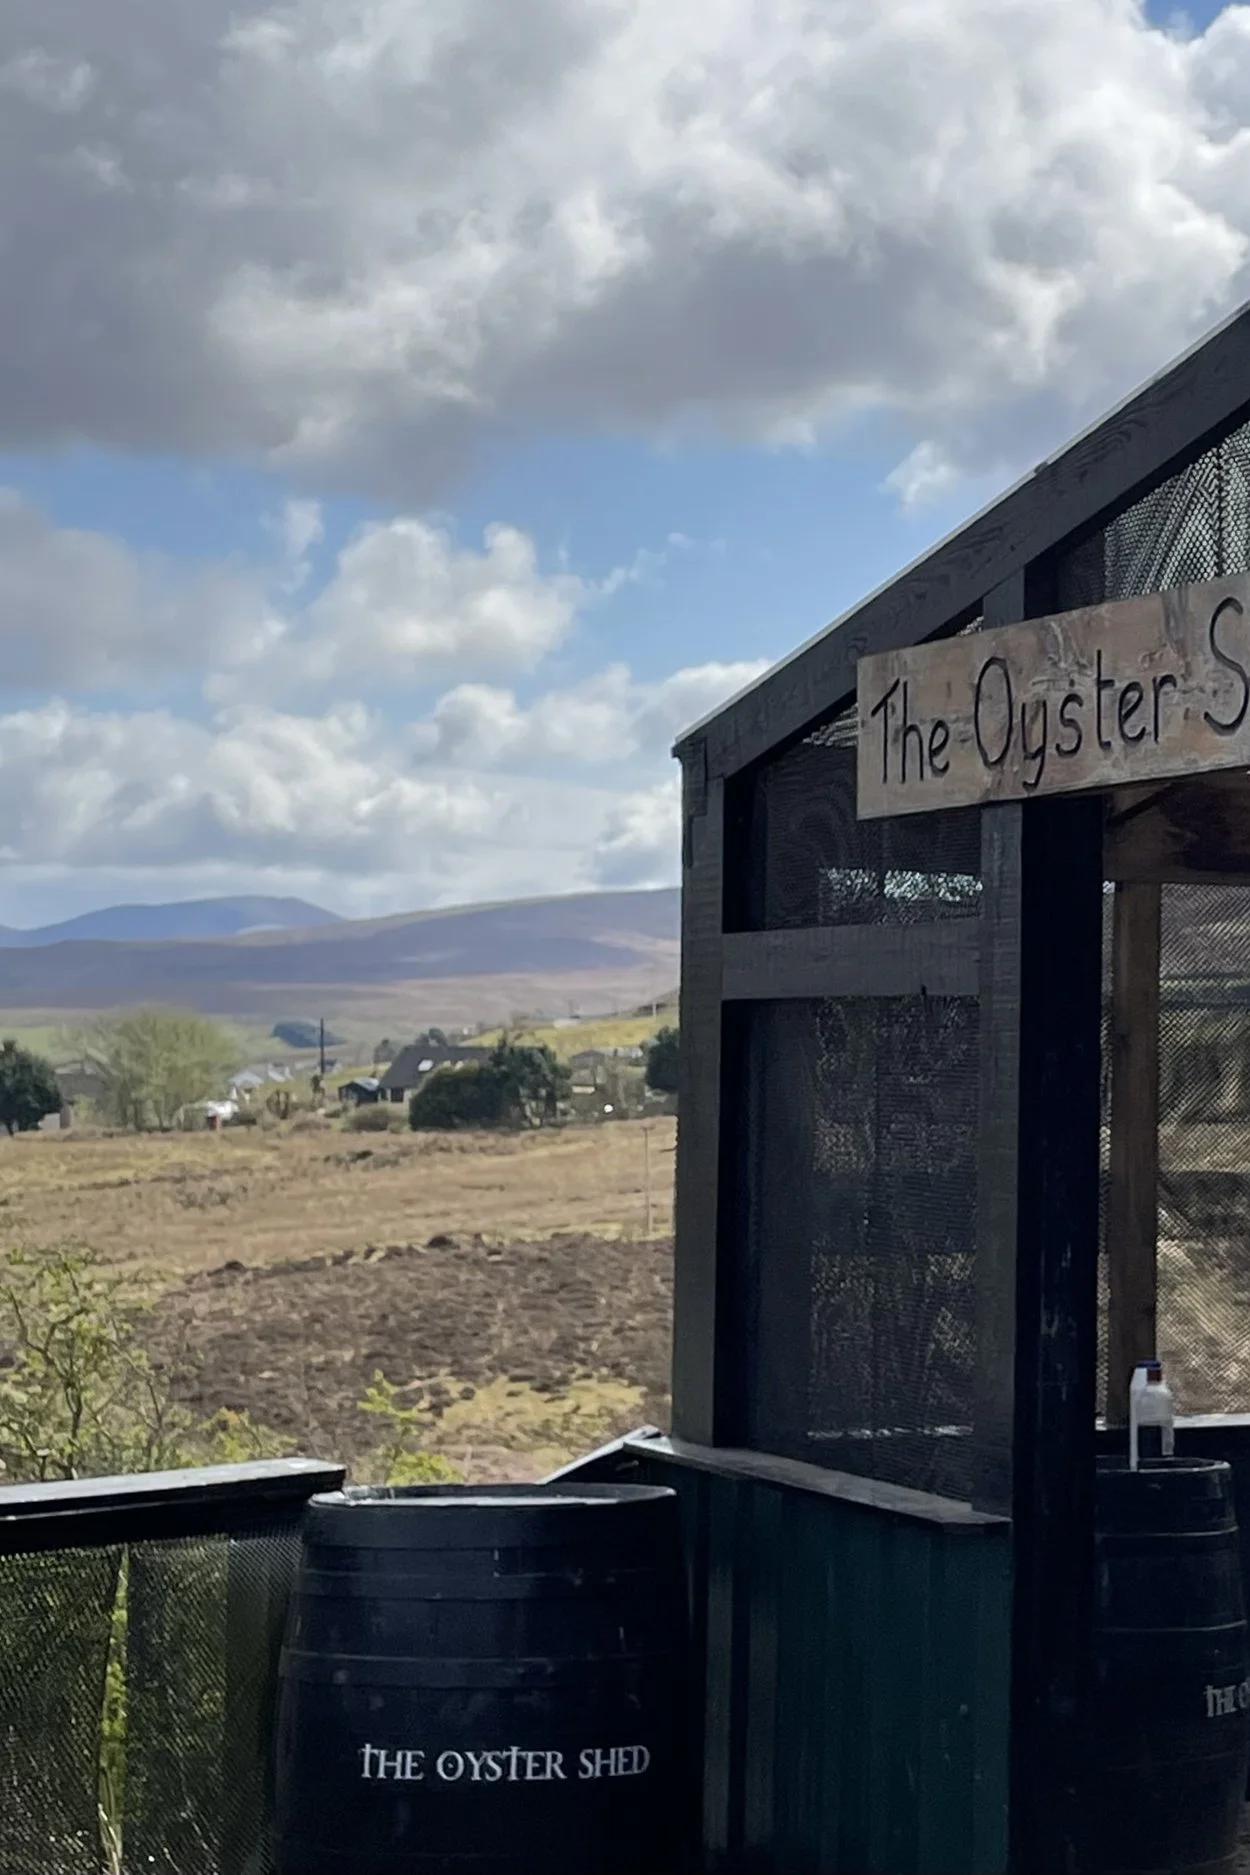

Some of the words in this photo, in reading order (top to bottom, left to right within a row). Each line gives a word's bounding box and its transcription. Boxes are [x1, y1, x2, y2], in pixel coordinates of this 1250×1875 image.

[871, 678, 950, 784] The
[973, 649, 1177, 790] Oyster
[359, 1743, 425, 1780] THE
[436, 1746, 567, 1781] OYSTER
[578, 1745, 650, 1779] SHED
